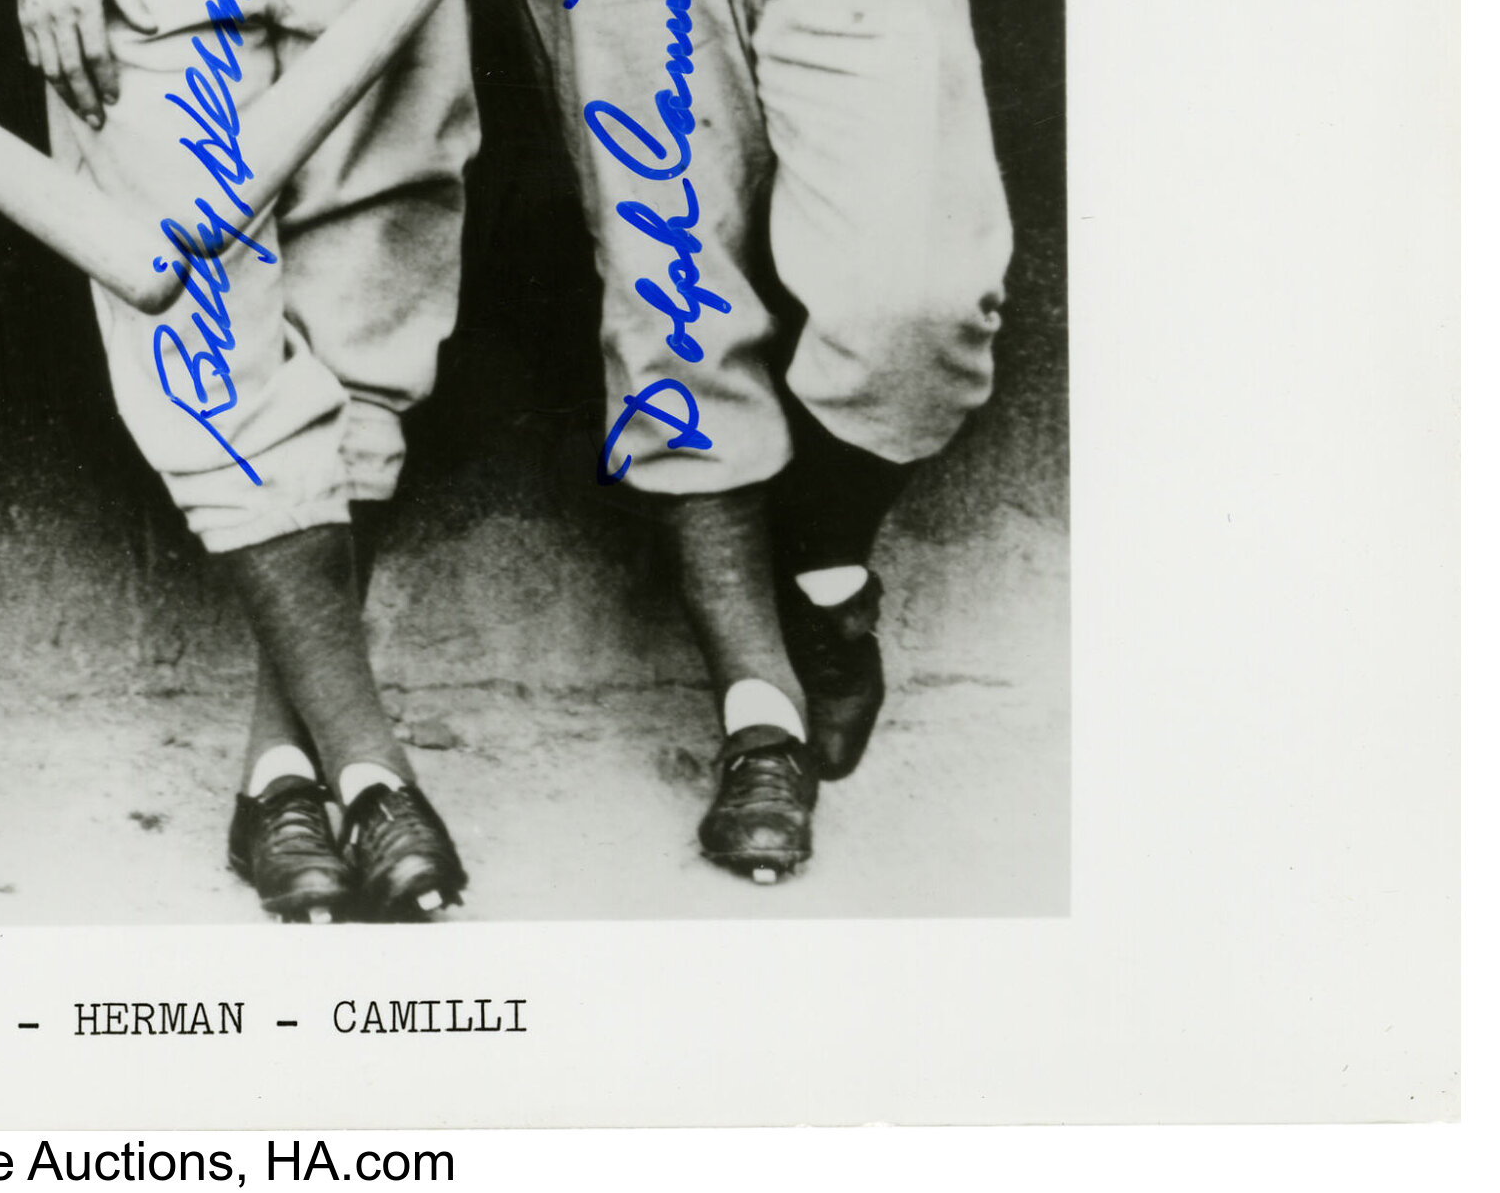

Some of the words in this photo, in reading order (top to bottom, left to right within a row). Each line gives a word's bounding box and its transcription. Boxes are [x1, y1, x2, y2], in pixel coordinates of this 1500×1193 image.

[153, 197, 278, 487] Billy
[598, 177, 732, 486] Dolph
[74, 1002, 245, 1036] HERMAN
[332, 999, 528, 1034] CAMILLI
